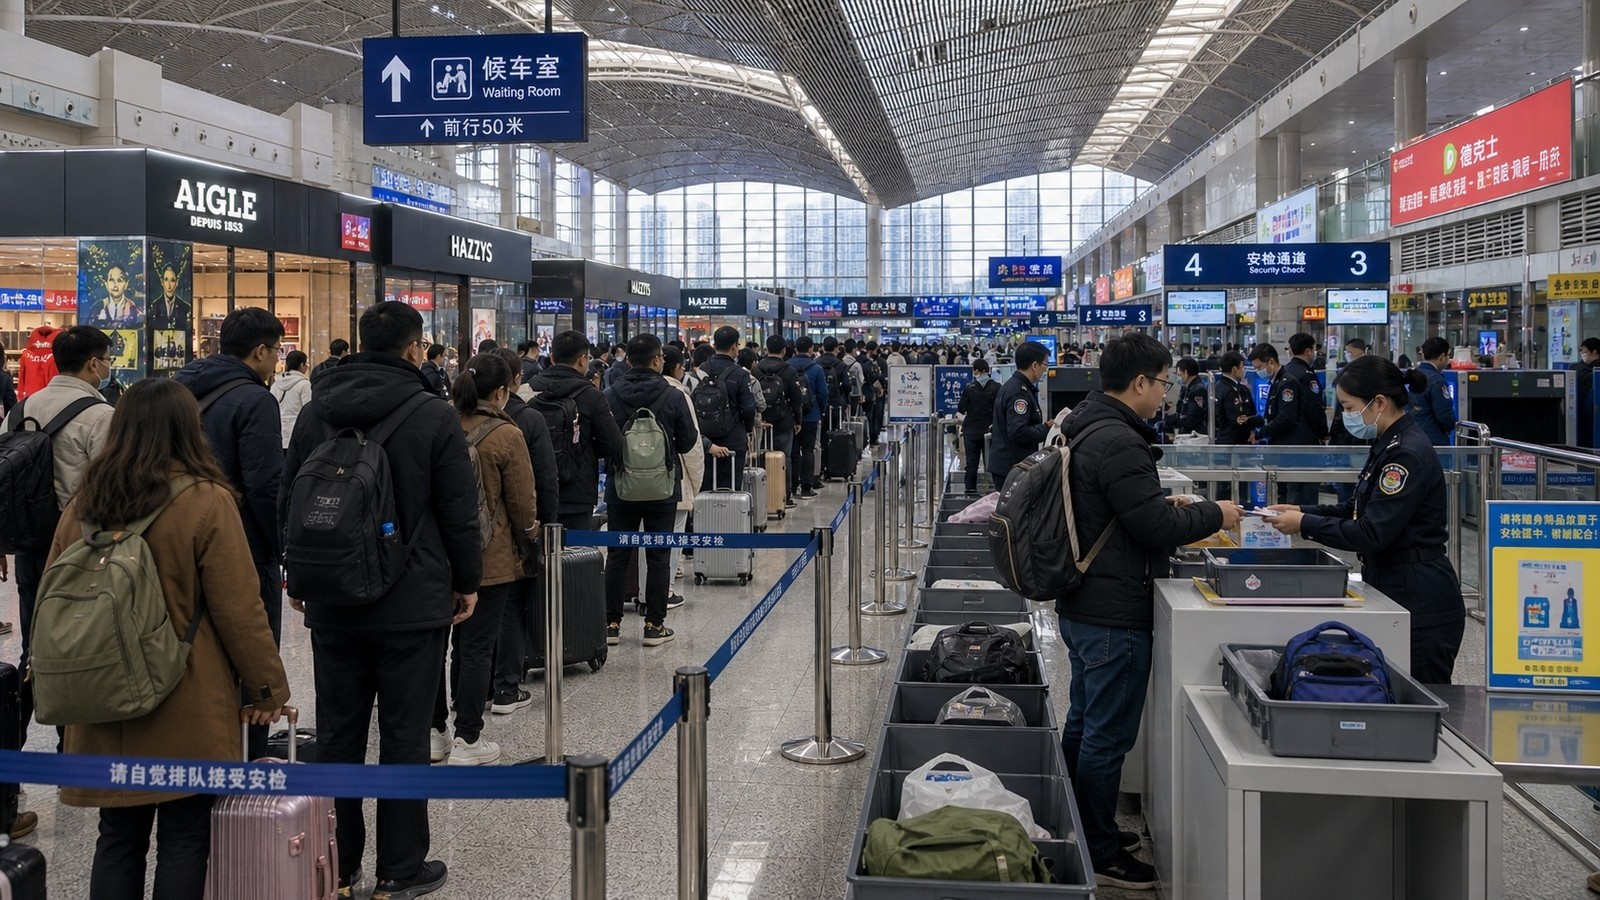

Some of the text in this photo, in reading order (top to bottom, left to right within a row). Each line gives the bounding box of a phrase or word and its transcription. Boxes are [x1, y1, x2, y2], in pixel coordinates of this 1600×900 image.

[482, 54, 560, 81] 候车室
[482, 86, 561, 100] Waiting Room
[443, 117, 524, 137] 前行50米
[174, 178, 257, 221] AIGLE
[190, 215, 222, 230] DEPUIS
[451, 235, 493, 263] HAZZYS
[1246, 251, 1306, 266] 安检通道
[1184, 252, 1203, 277] 4
[1249, 266, 1306, 275] Security Check
[1350, 250, 1368, 276] 3
[109, 761, 288, 791] 请自觉排队接受安检
